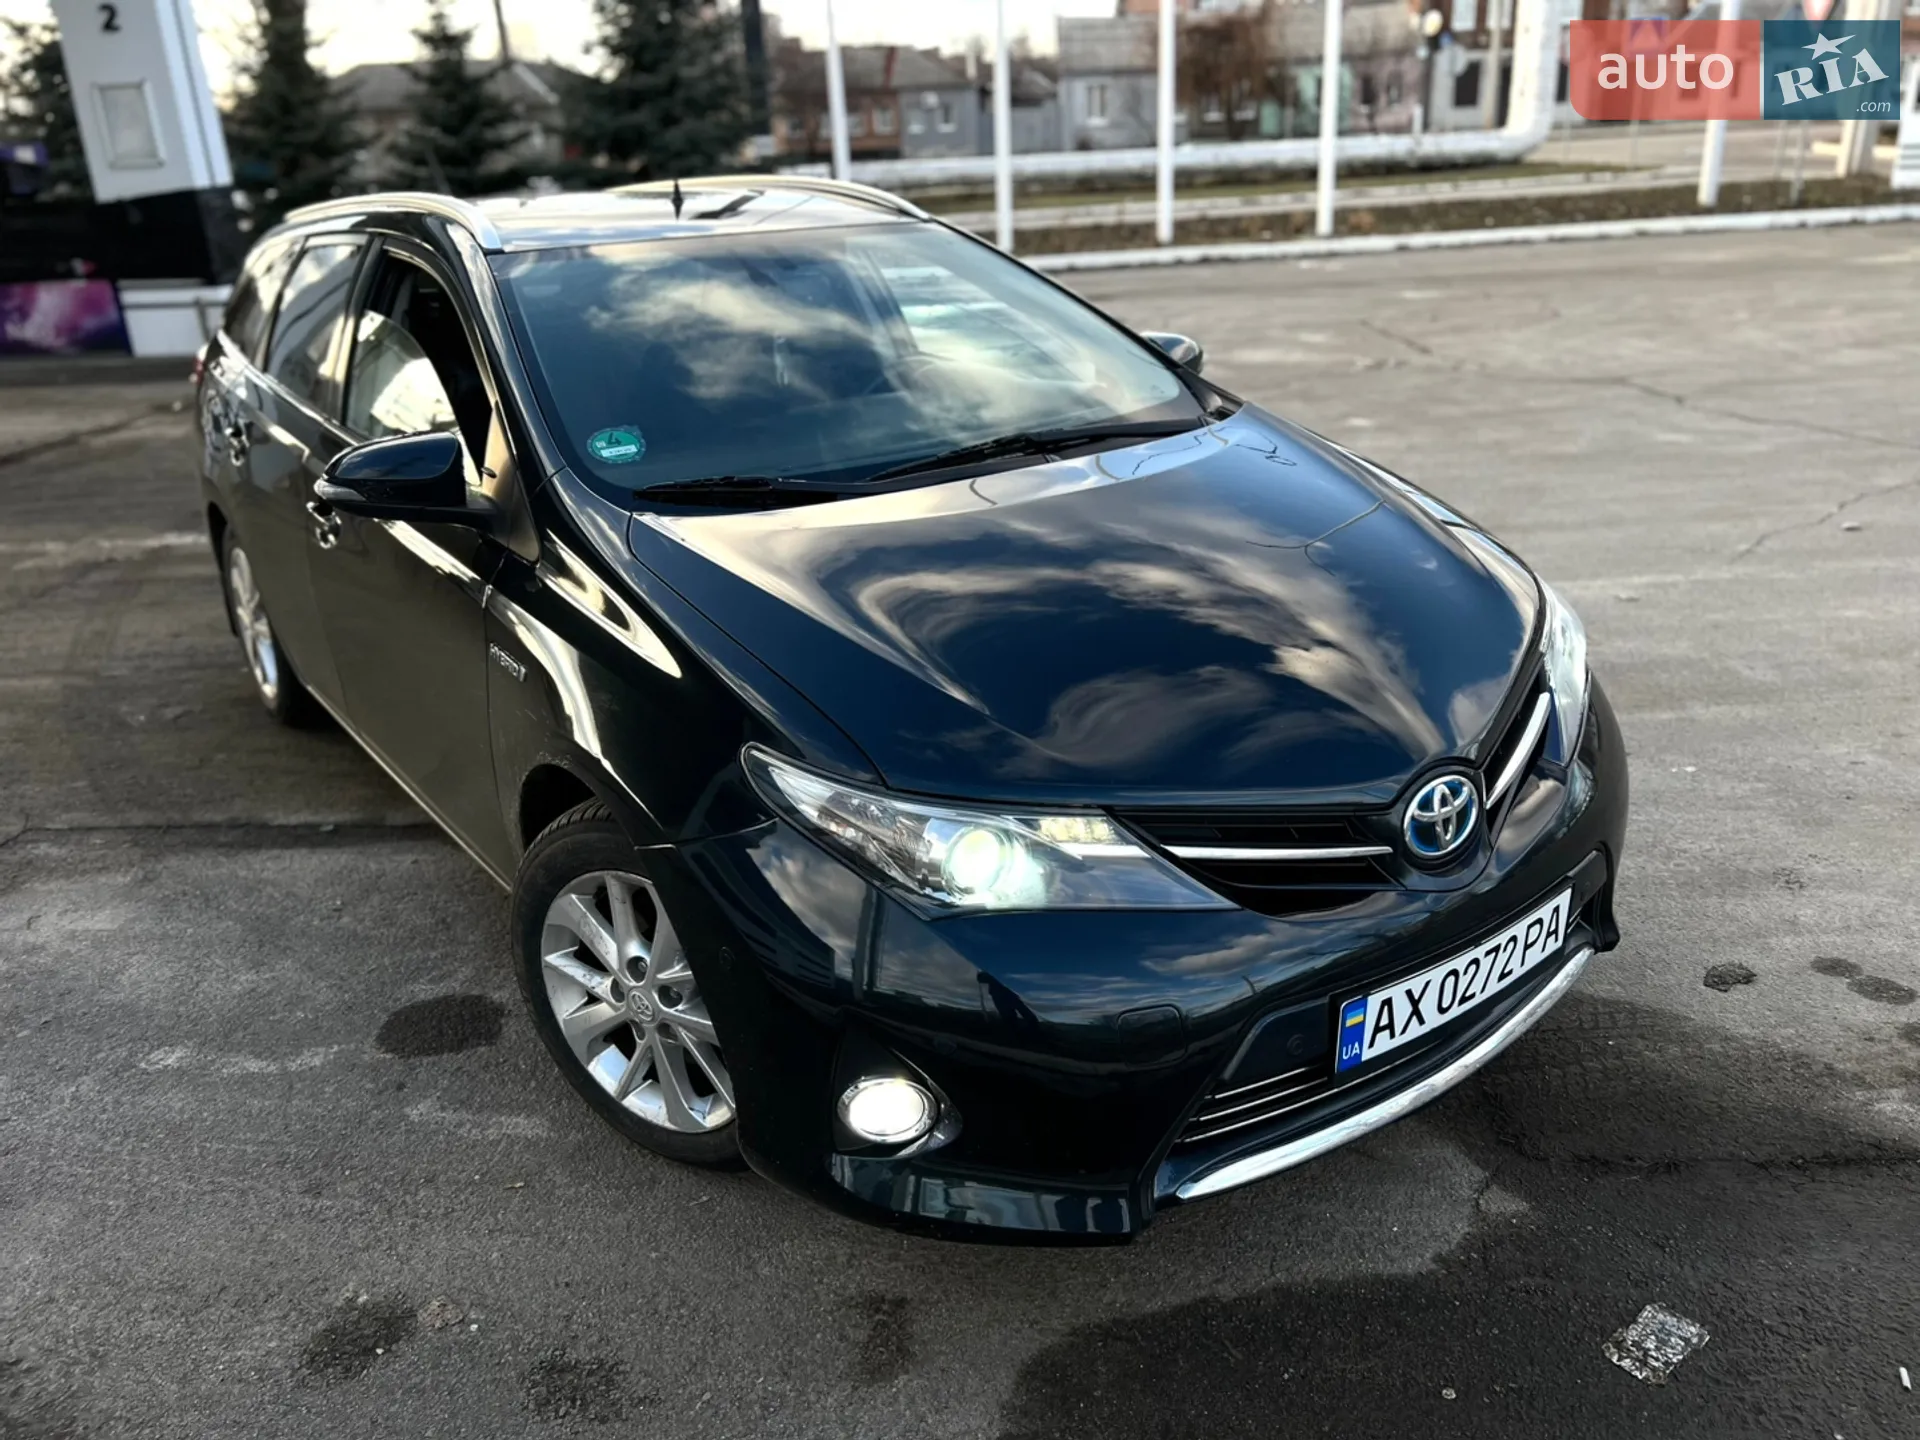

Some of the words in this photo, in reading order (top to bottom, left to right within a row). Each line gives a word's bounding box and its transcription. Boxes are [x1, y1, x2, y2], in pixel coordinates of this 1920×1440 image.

[98, 4, 122, 33] 2
[1368, 979, 1432, 1049] AX
[1436, 934, 1518, 1016] 0272
[1520, 904, 1561, 968] PA
[1342, 1040, 1361, 1060] UA
